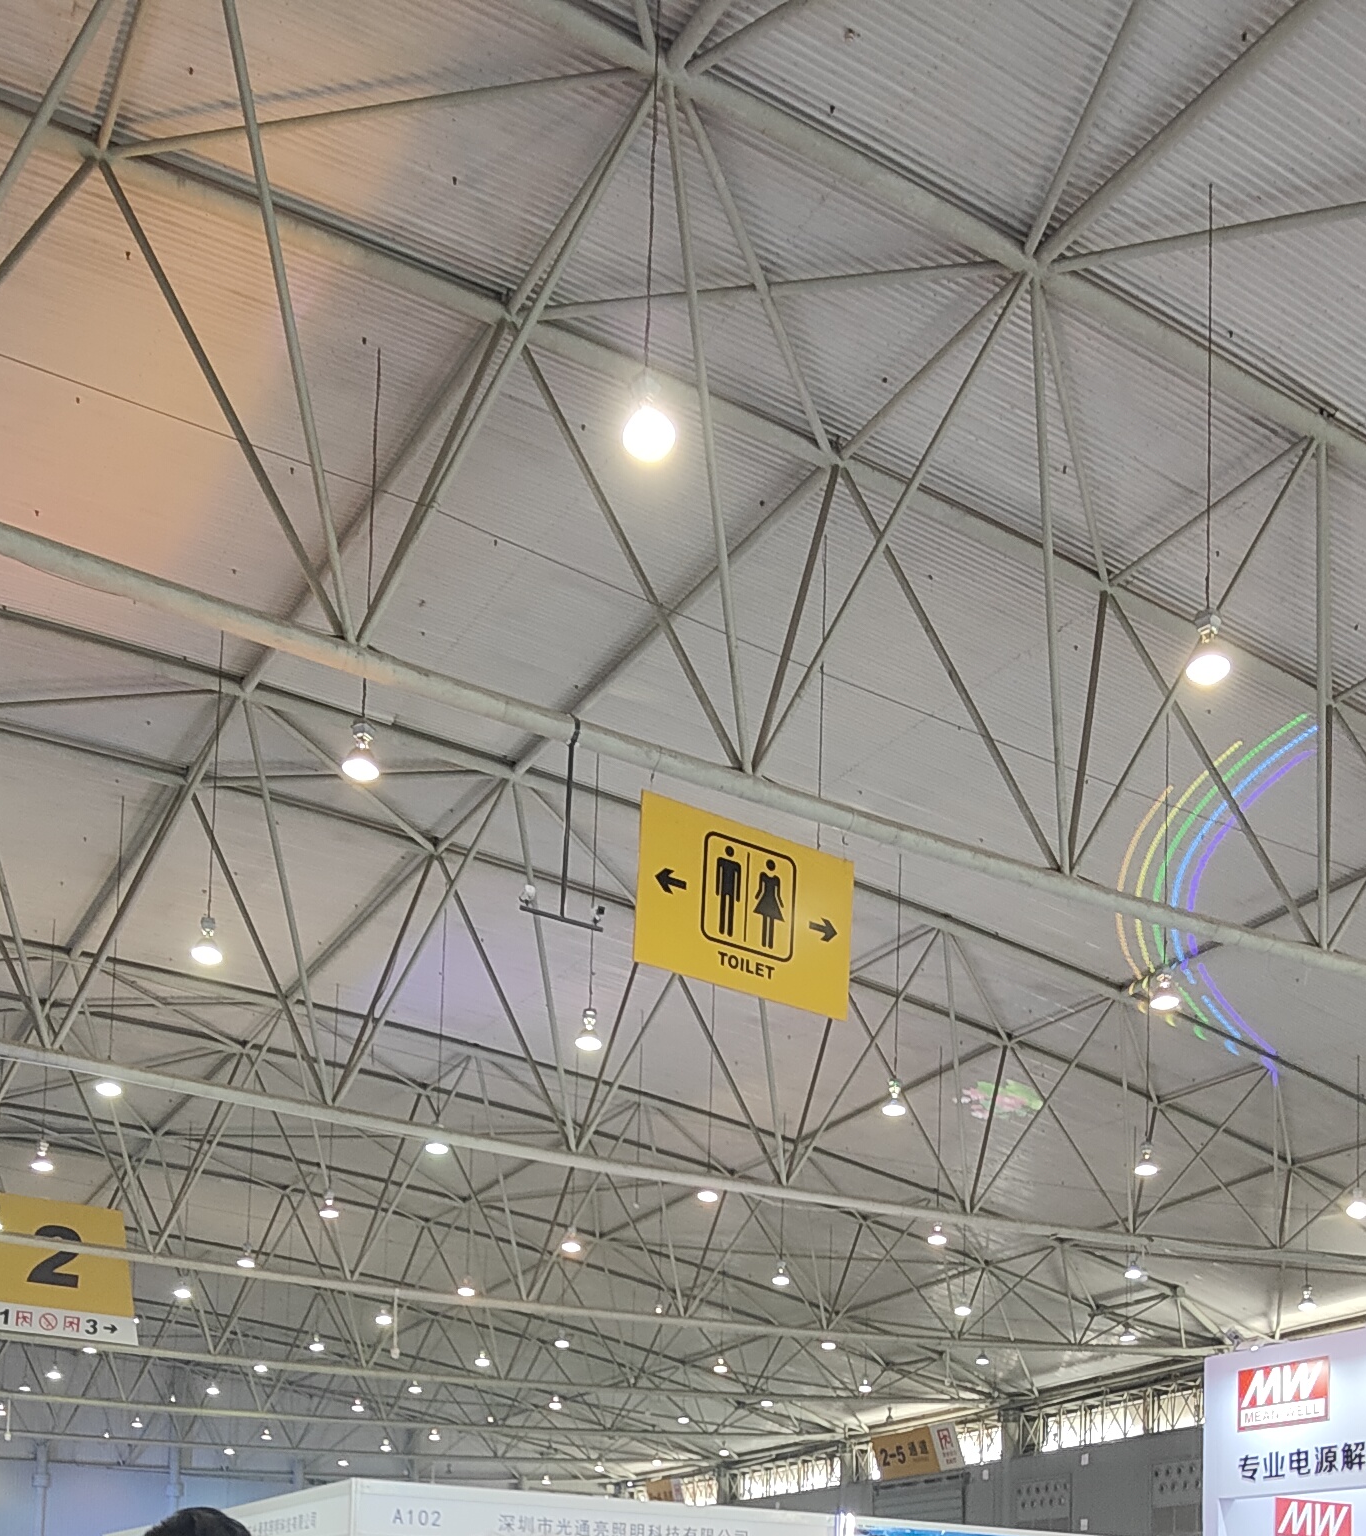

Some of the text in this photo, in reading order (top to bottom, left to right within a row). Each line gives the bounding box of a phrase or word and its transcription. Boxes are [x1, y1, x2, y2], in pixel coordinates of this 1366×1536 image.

[718, 950, 775, 980] TOILET
[26, 1224, 82, 1289] 2
[0, 1308, 10, 1325] 1
[85, 1319, 98, 1335] 3
[1241, 1360, 1323, 1408] MW
[880, 1445, 906, 1466] 2-5
[392, 1508, 441, 1528] A102
